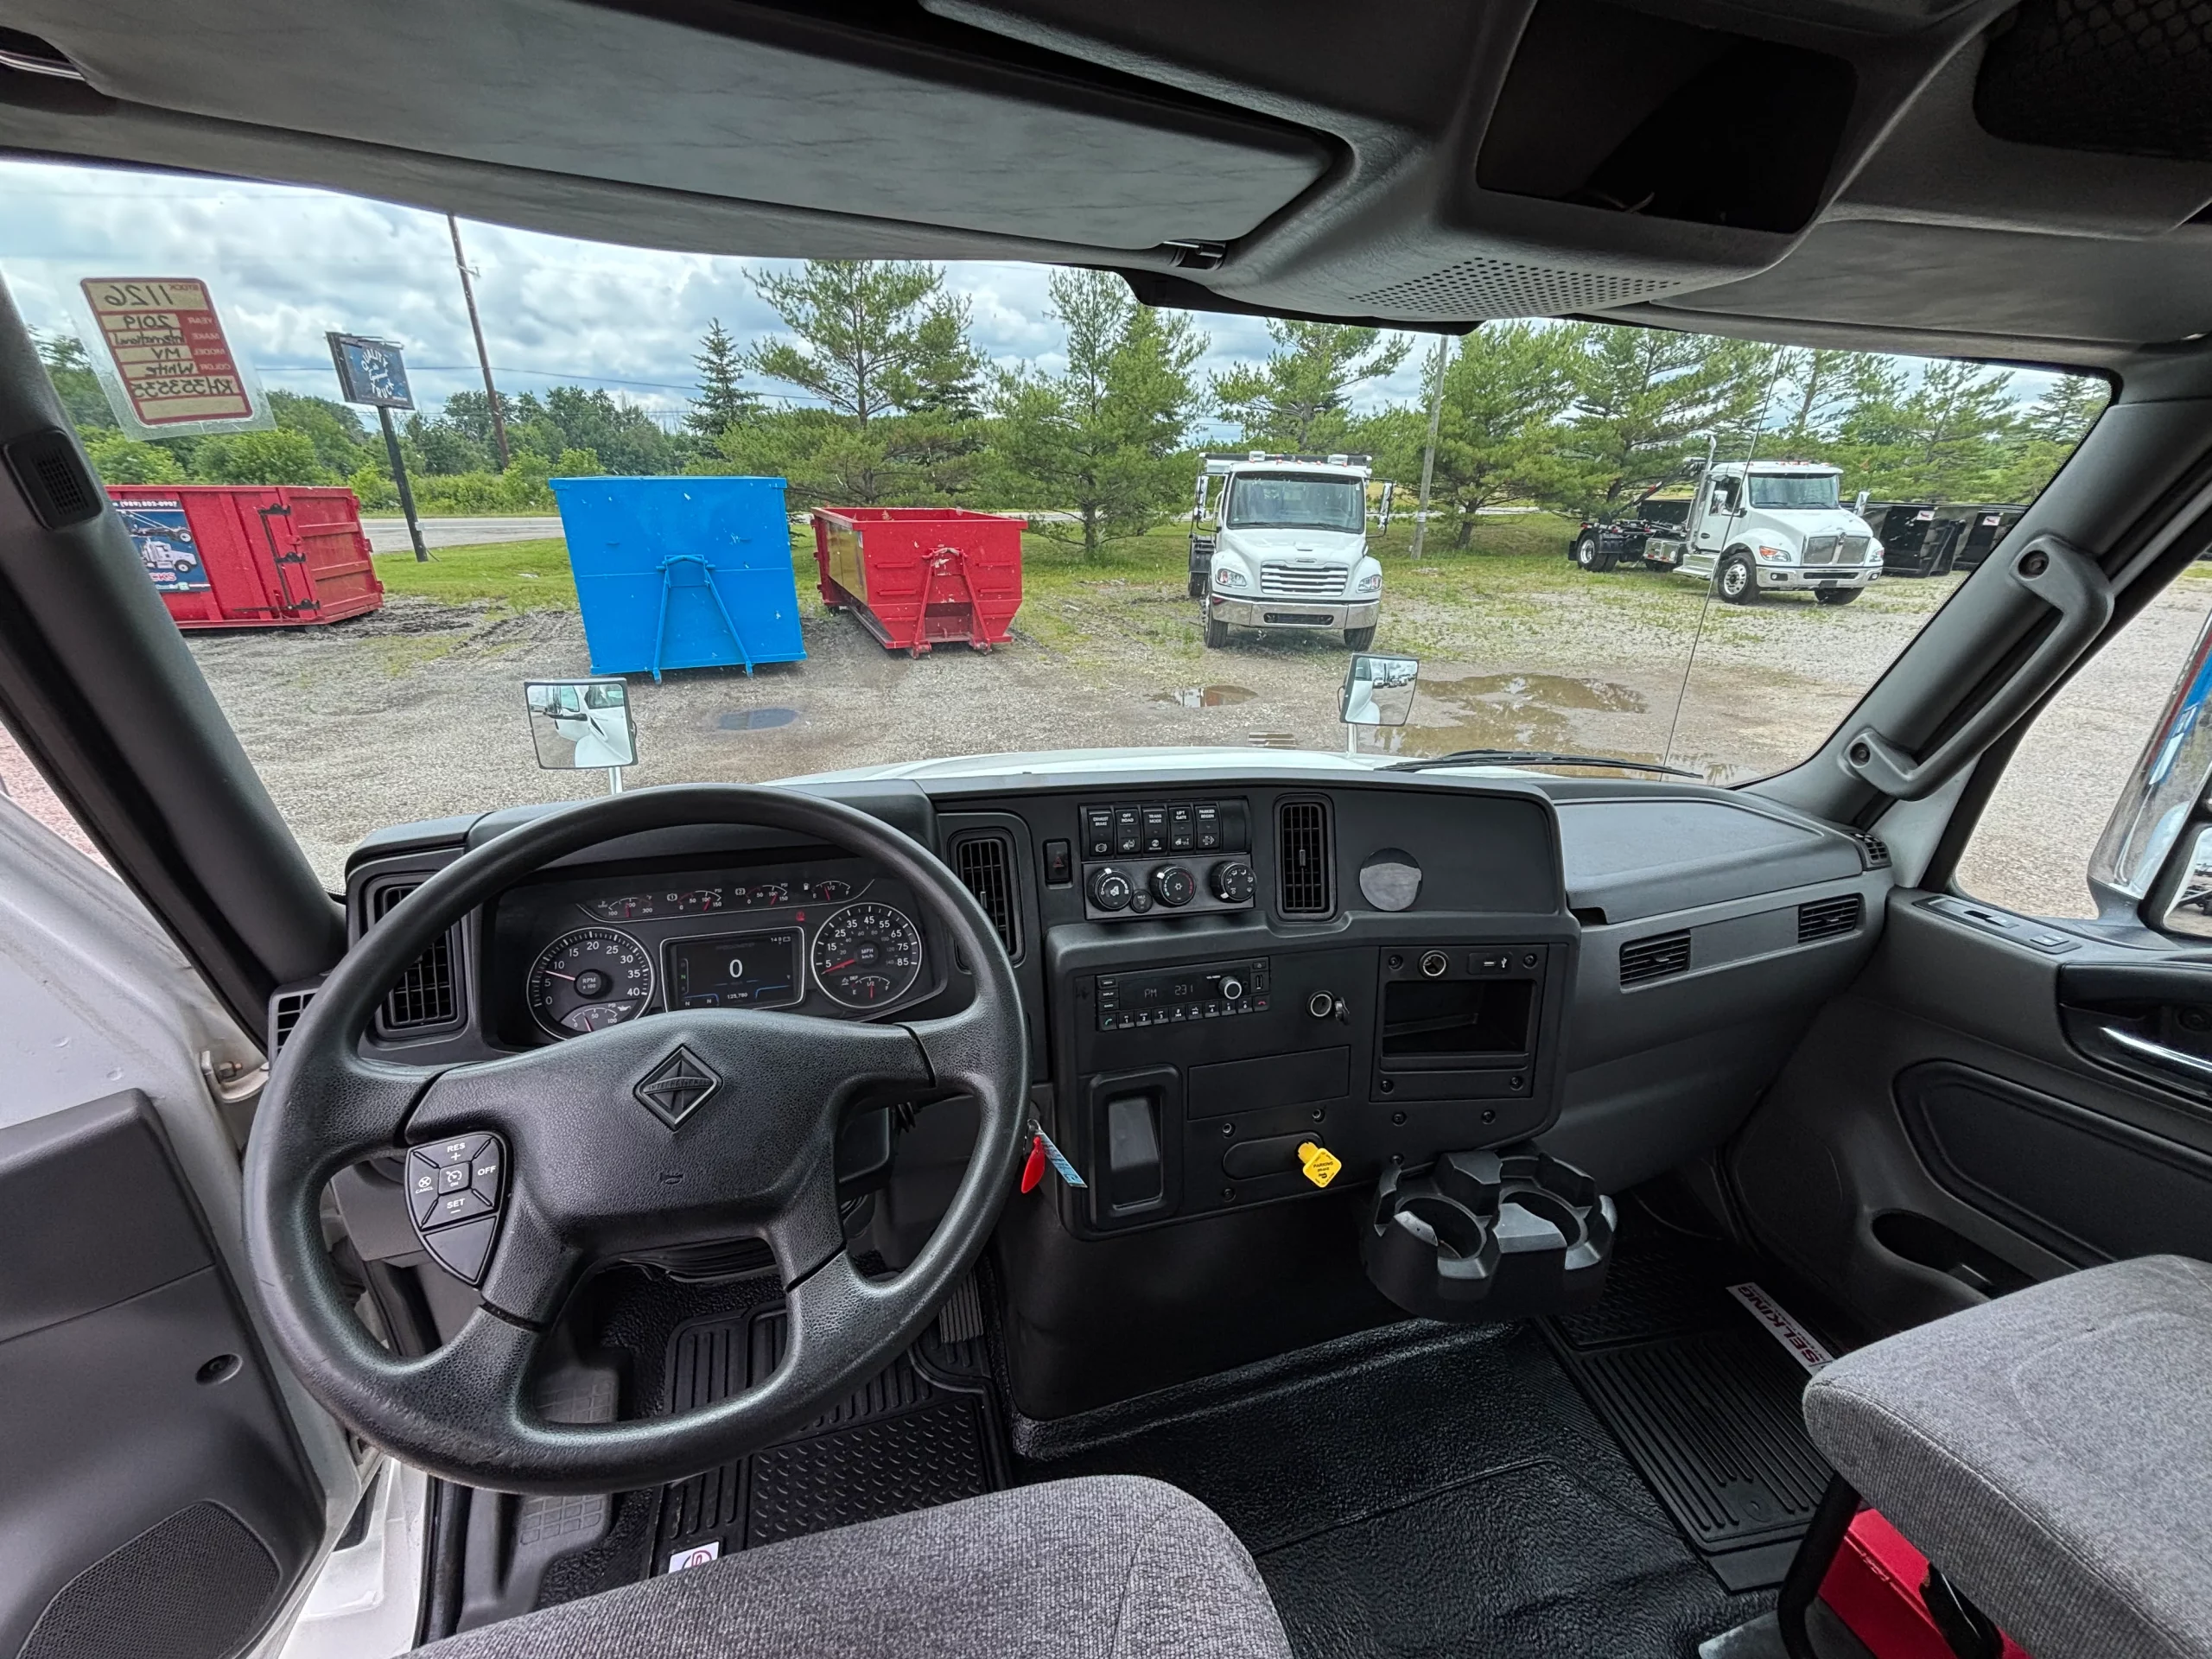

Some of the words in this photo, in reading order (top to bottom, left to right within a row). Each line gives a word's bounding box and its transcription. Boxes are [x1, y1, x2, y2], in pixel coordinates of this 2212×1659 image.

[361, 348, 388, 372] QUALITY
[371, 378, 394, 398] TRUCK
[847, 919, 857, 928] 35
[587, 941, 600, 950] 20
[606, 945, 619, 954] 25
[569, 948, 579, 957] 15
[620, 955, 633, 963] 30
[729, 959, 743, 978] 0
[627, 969, 640, 978] 35
[544, 978, 551, 987] 5
[626, 988, 640, 996] 40
[1144, 988, 1157, 998] PM
[545, 996, 552, 1005] 0
[447, 1142, 466, 1153] RES
[477, 1166, 496, 1176] OFF
[447, 1198, 465, 1209] SET
[1738, 1286, 1820, 1363] SELKING
